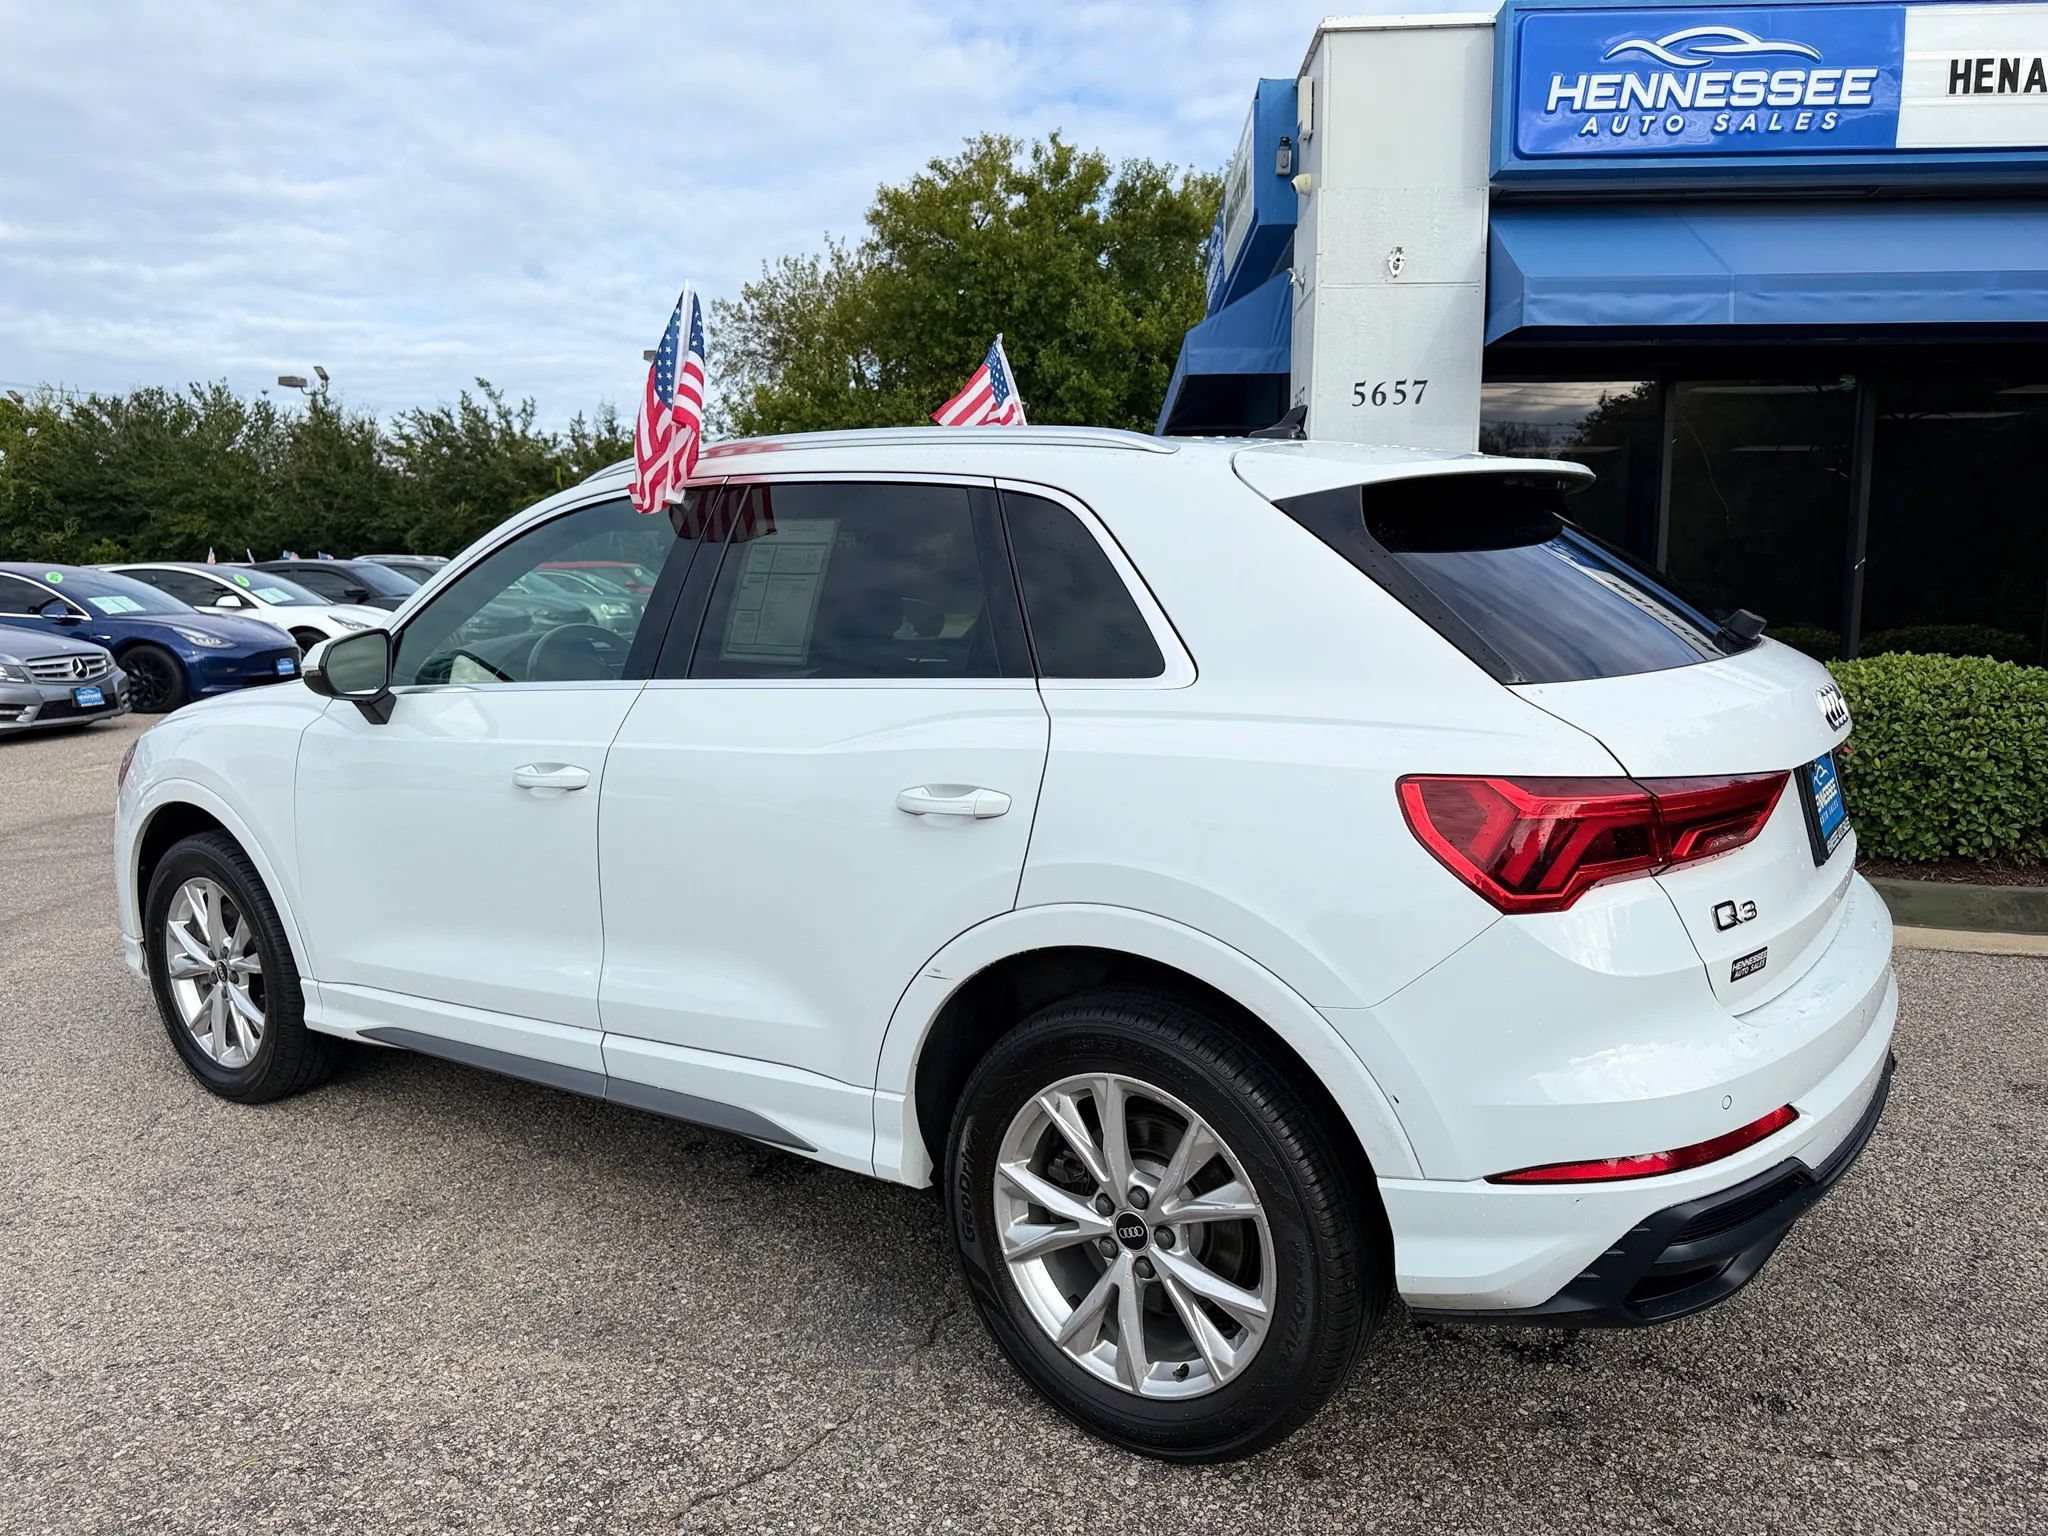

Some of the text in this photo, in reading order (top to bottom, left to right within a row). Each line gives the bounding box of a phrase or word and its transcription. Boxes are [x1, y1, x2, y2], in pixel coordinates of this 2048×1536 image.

[1546, 67, 1877, 111] HENNESSEE
[1949, 57, 2048, 94] HENA
[1580, 111, 1838, 135] AUTO SALES
[1351, 378, 1428, 407] 5657
[1711, 899, 1758, 933] Q3
[1731, 951, 1768, 971] HENNESSEE
[1733, 960, 1765, 980] AUTO SALES
